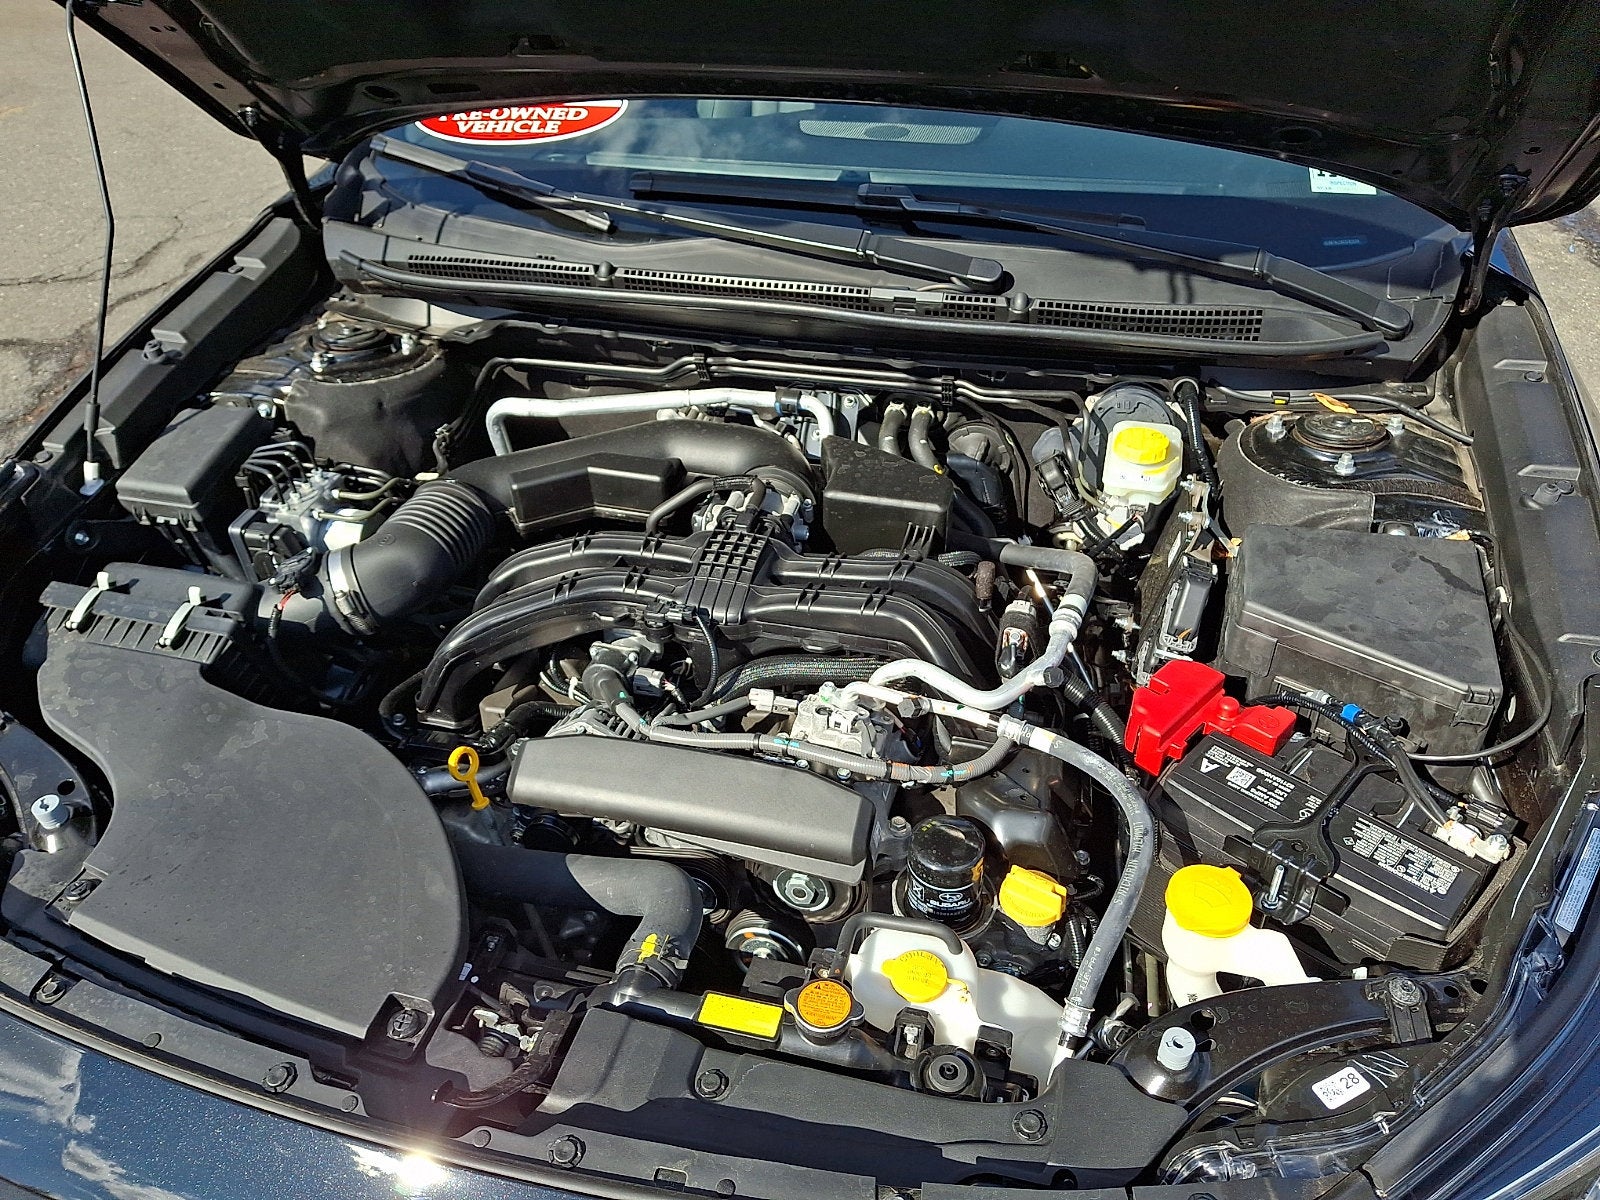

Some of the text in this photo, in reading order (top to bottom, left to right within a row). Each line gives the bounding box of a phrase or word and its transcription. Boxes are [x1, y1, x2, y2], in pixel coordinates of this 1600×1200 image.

[438, 107, 588, 121] RE-OWNED
[457, 120, 562, 133] VEHICLE
[929, 898, 971, 908] SUBARU
[1339, 1072, 1360, 1089] 28
